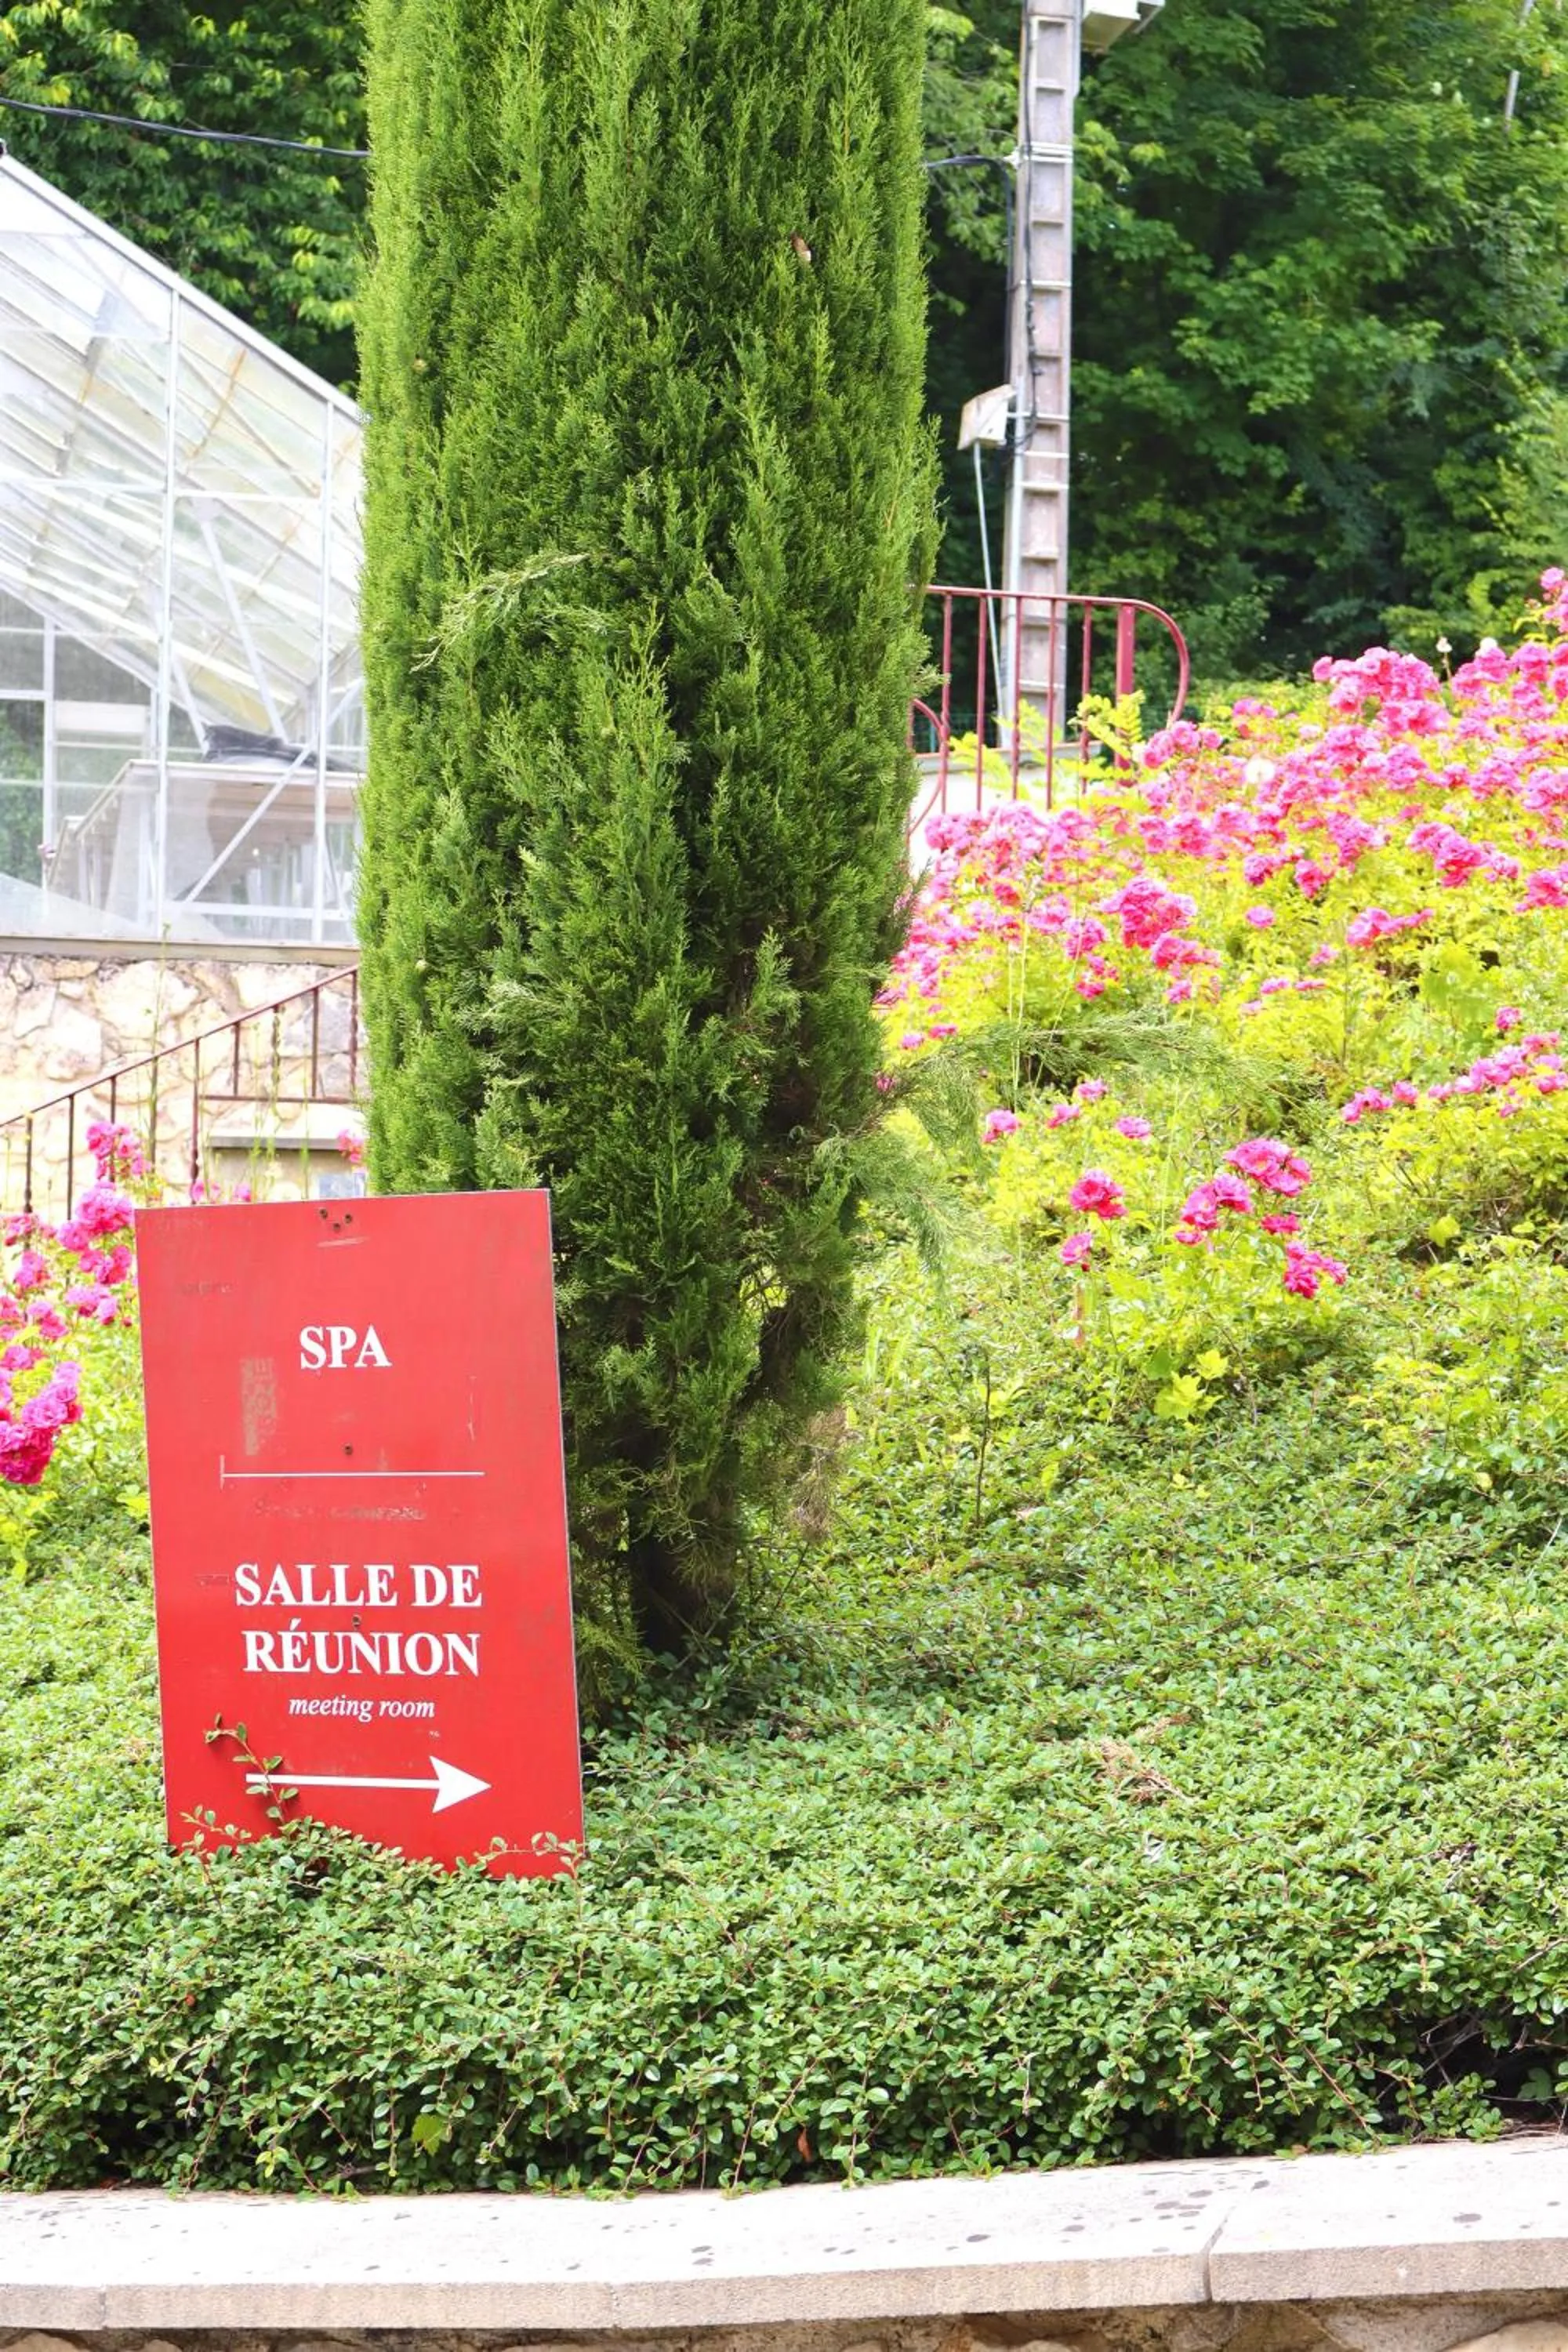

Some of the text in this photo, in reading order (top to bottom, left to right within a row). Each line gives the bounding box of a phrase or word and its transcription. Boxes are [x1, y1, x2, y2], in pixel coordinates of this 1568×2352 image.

[299, 1325, 392, 1370] SPA
[234, 1563, 483, 1608] SALLE DE
[241, 1619, 480, 1676] RÉUNION
[288, 1695, 436, 1722] meeting room
